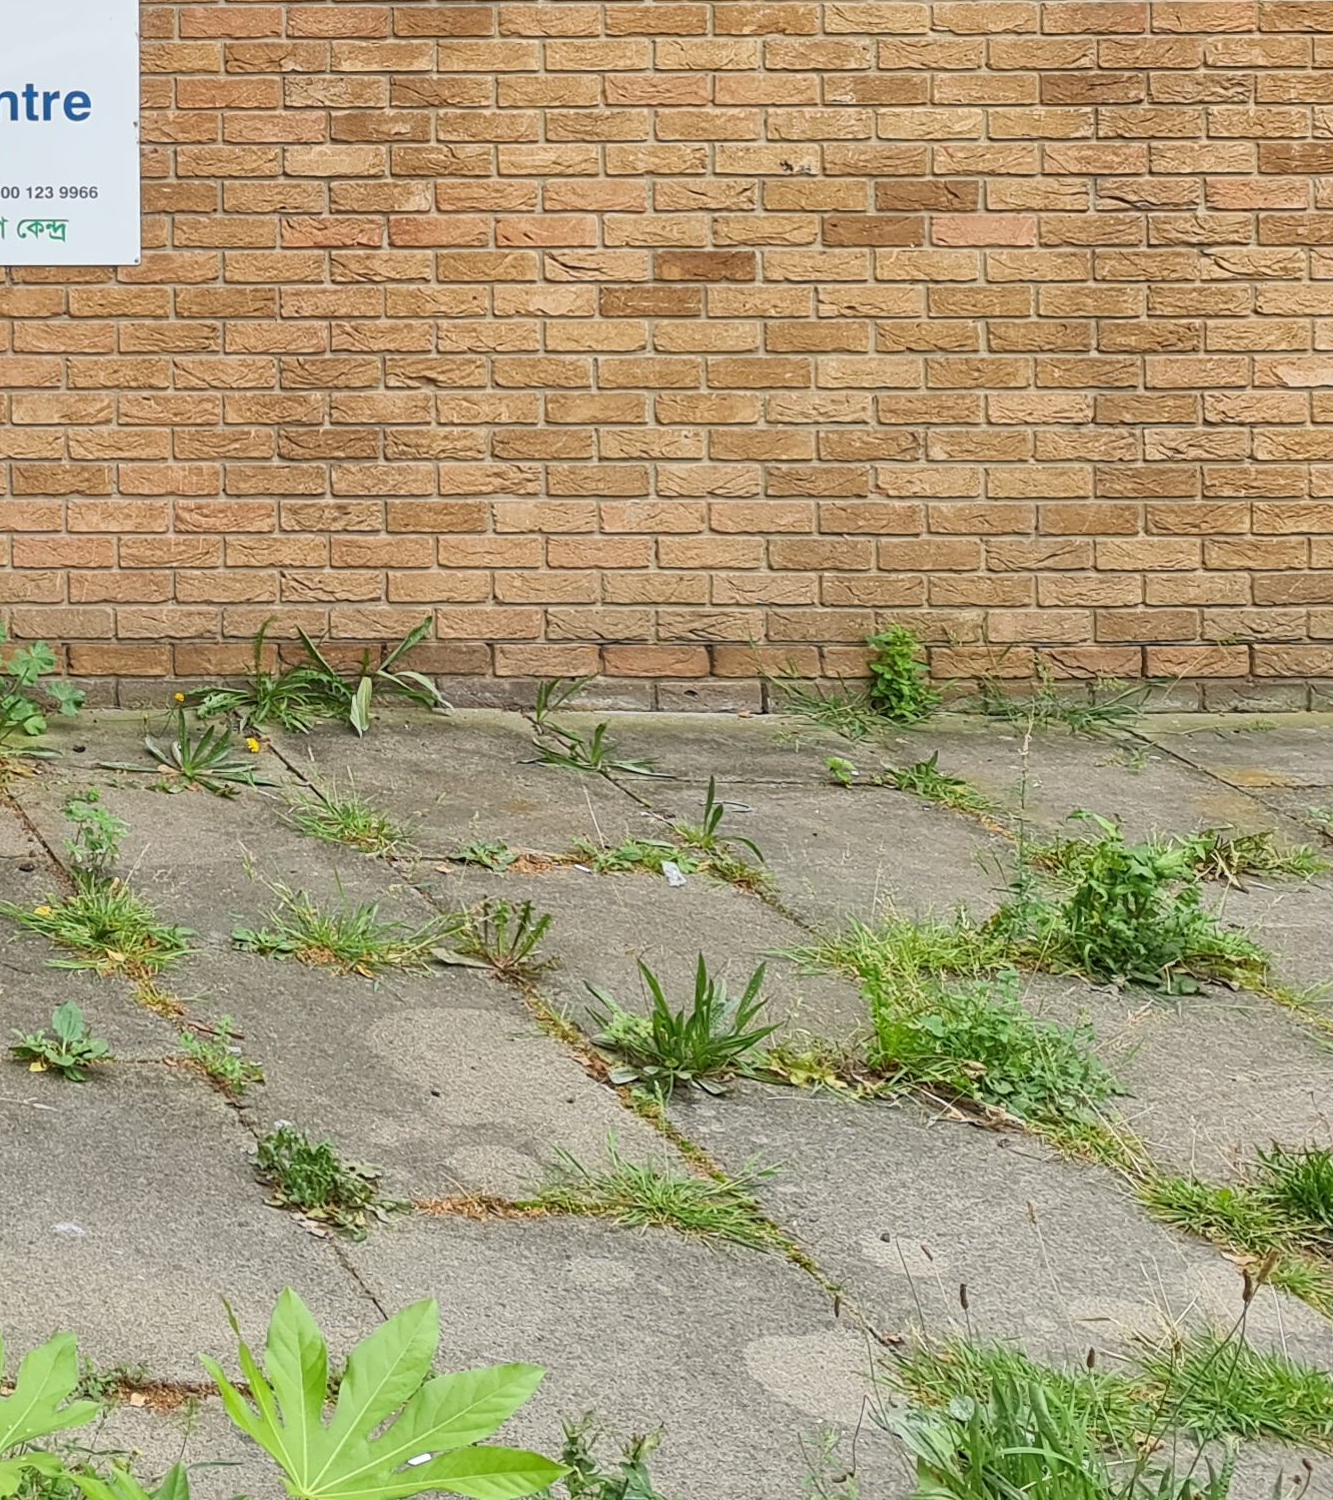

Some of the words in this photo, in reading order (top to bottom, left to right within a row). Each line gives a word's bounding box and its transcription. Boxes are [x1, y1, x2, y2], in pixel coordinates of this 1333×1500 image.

[26, 186, 54, 199] 123
[59, 186, 99, 199] 9966
[16, 218, 69, 243] কেন্দ্র
